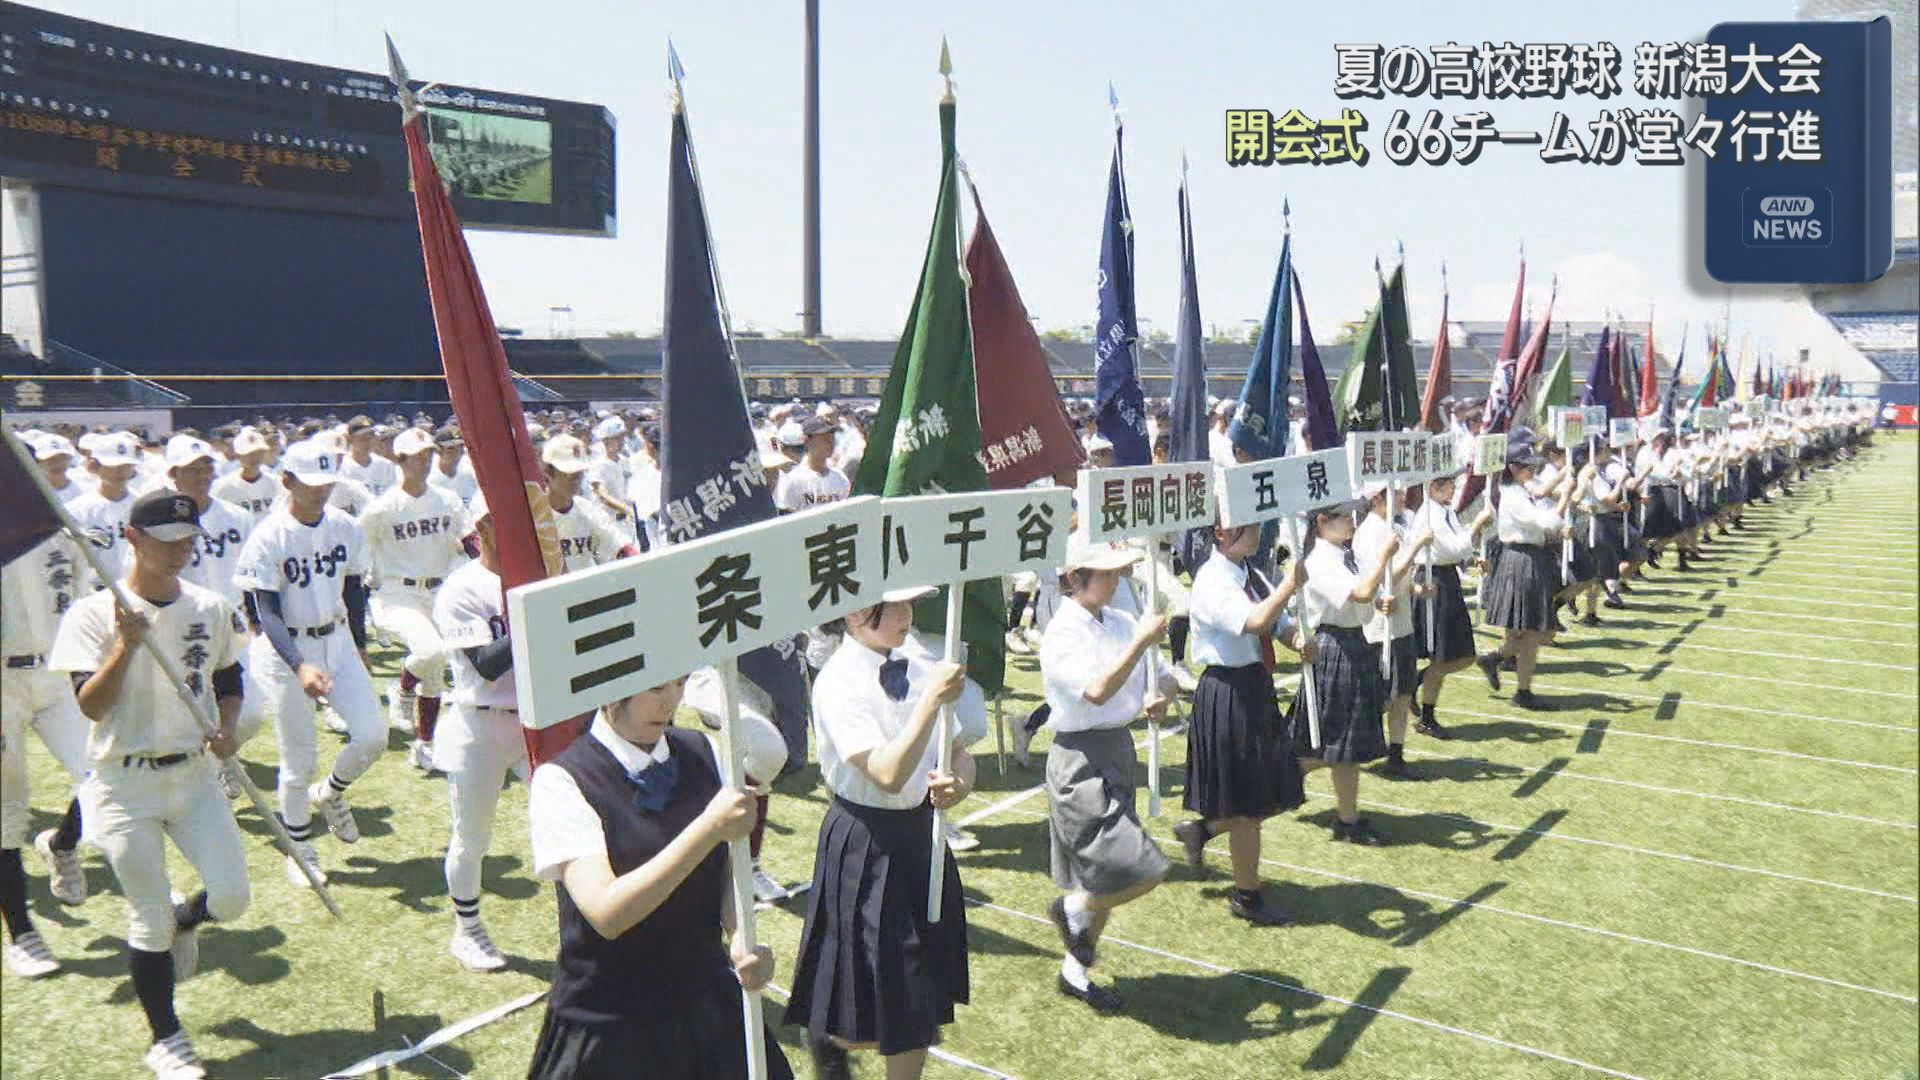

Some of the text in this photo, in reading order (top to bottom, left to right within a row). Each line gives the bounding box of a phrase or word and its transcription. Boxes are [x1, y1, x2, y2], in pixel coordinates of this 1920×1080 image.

[1101, 471, 1208, 533] 長岡向陵
[1252, 461, 1332, 513] 五泉
[283, 544, 348, 589] Ojiya
[566, 522, 860, 694] 三条東
